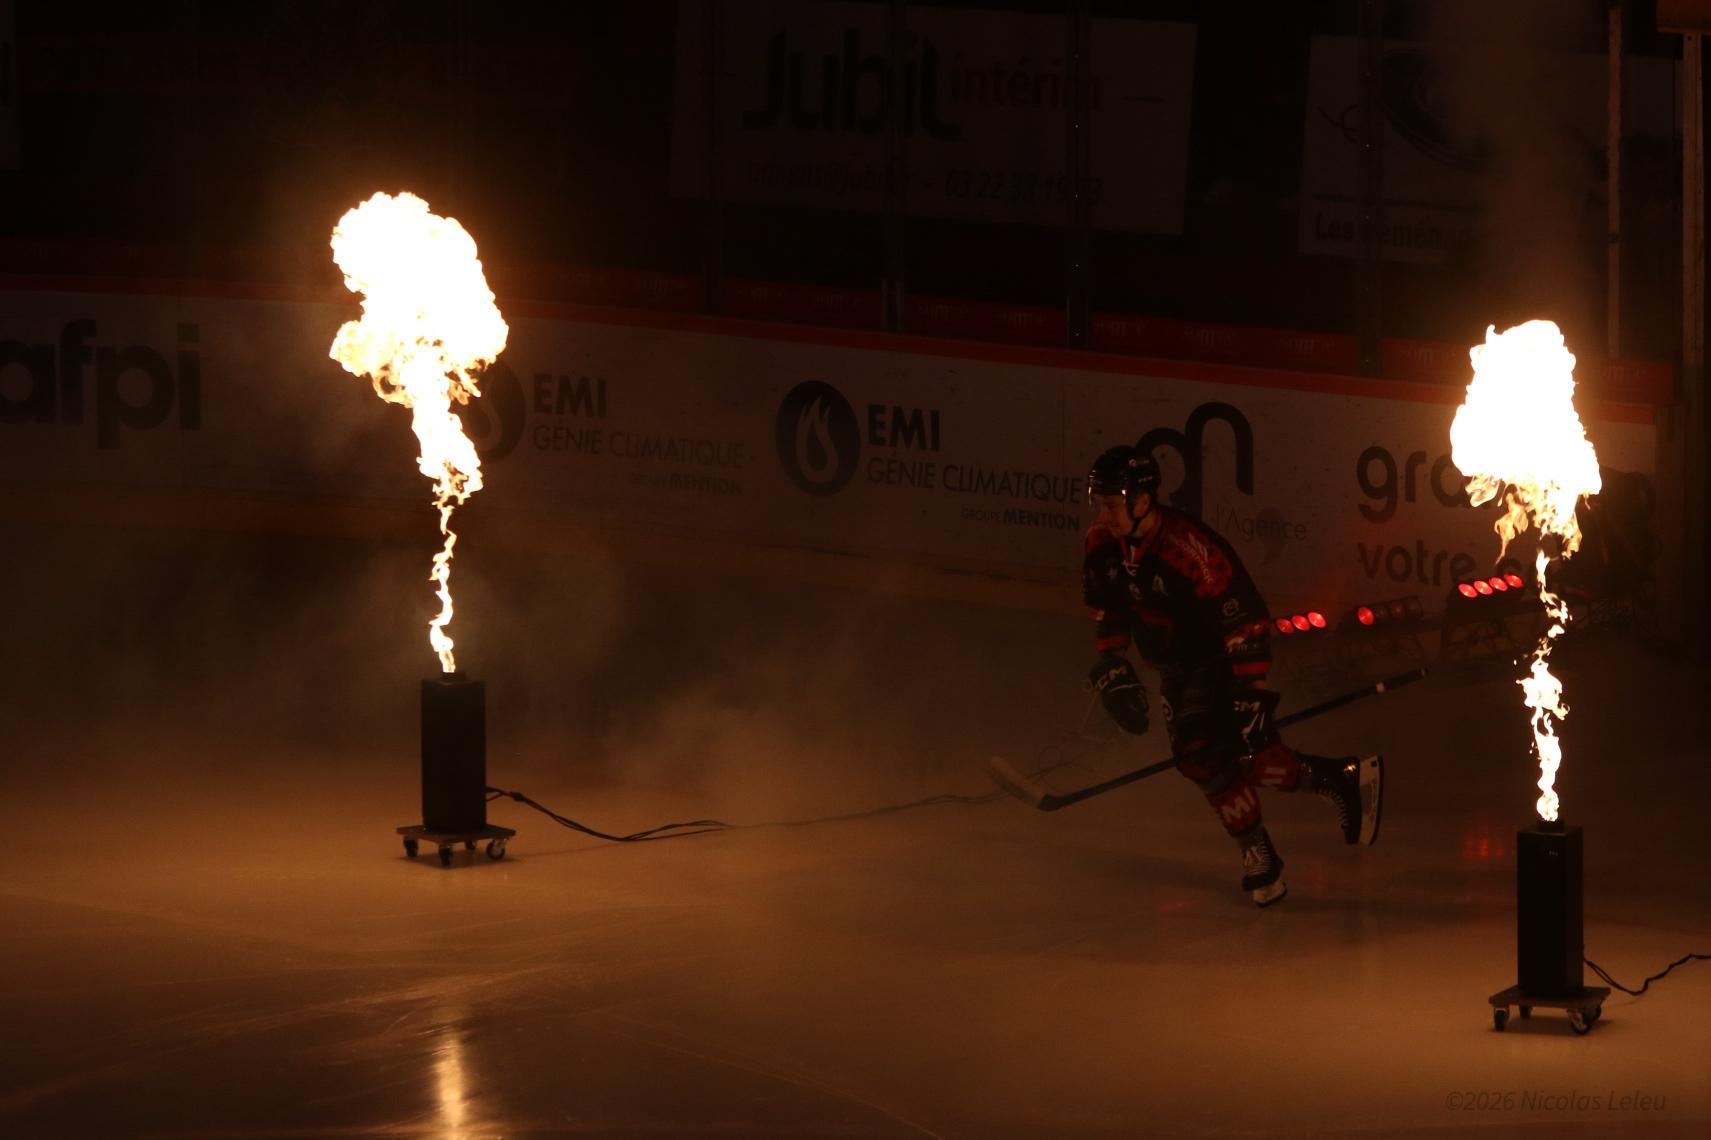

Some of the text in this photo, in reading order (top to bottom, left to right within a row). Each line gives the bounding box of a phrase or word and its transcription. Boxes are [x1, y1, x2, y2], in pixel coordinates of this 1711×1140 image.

[742, 28, 961, 142] Jubil
[0, 319, 200, 450] afpi
[533, 373, 607, 420] EMI
[608, 431, 746, 470] CLIMATIQUE
[867, 403, 940, 452] EMI
[942, 464, 1081, 505] CLIMATIQUE
[1003, 509, 1080, 531] MENTION
[1215, 502, 1307, 543] l'Agence
[1357, 538, 1478, 588] votre
